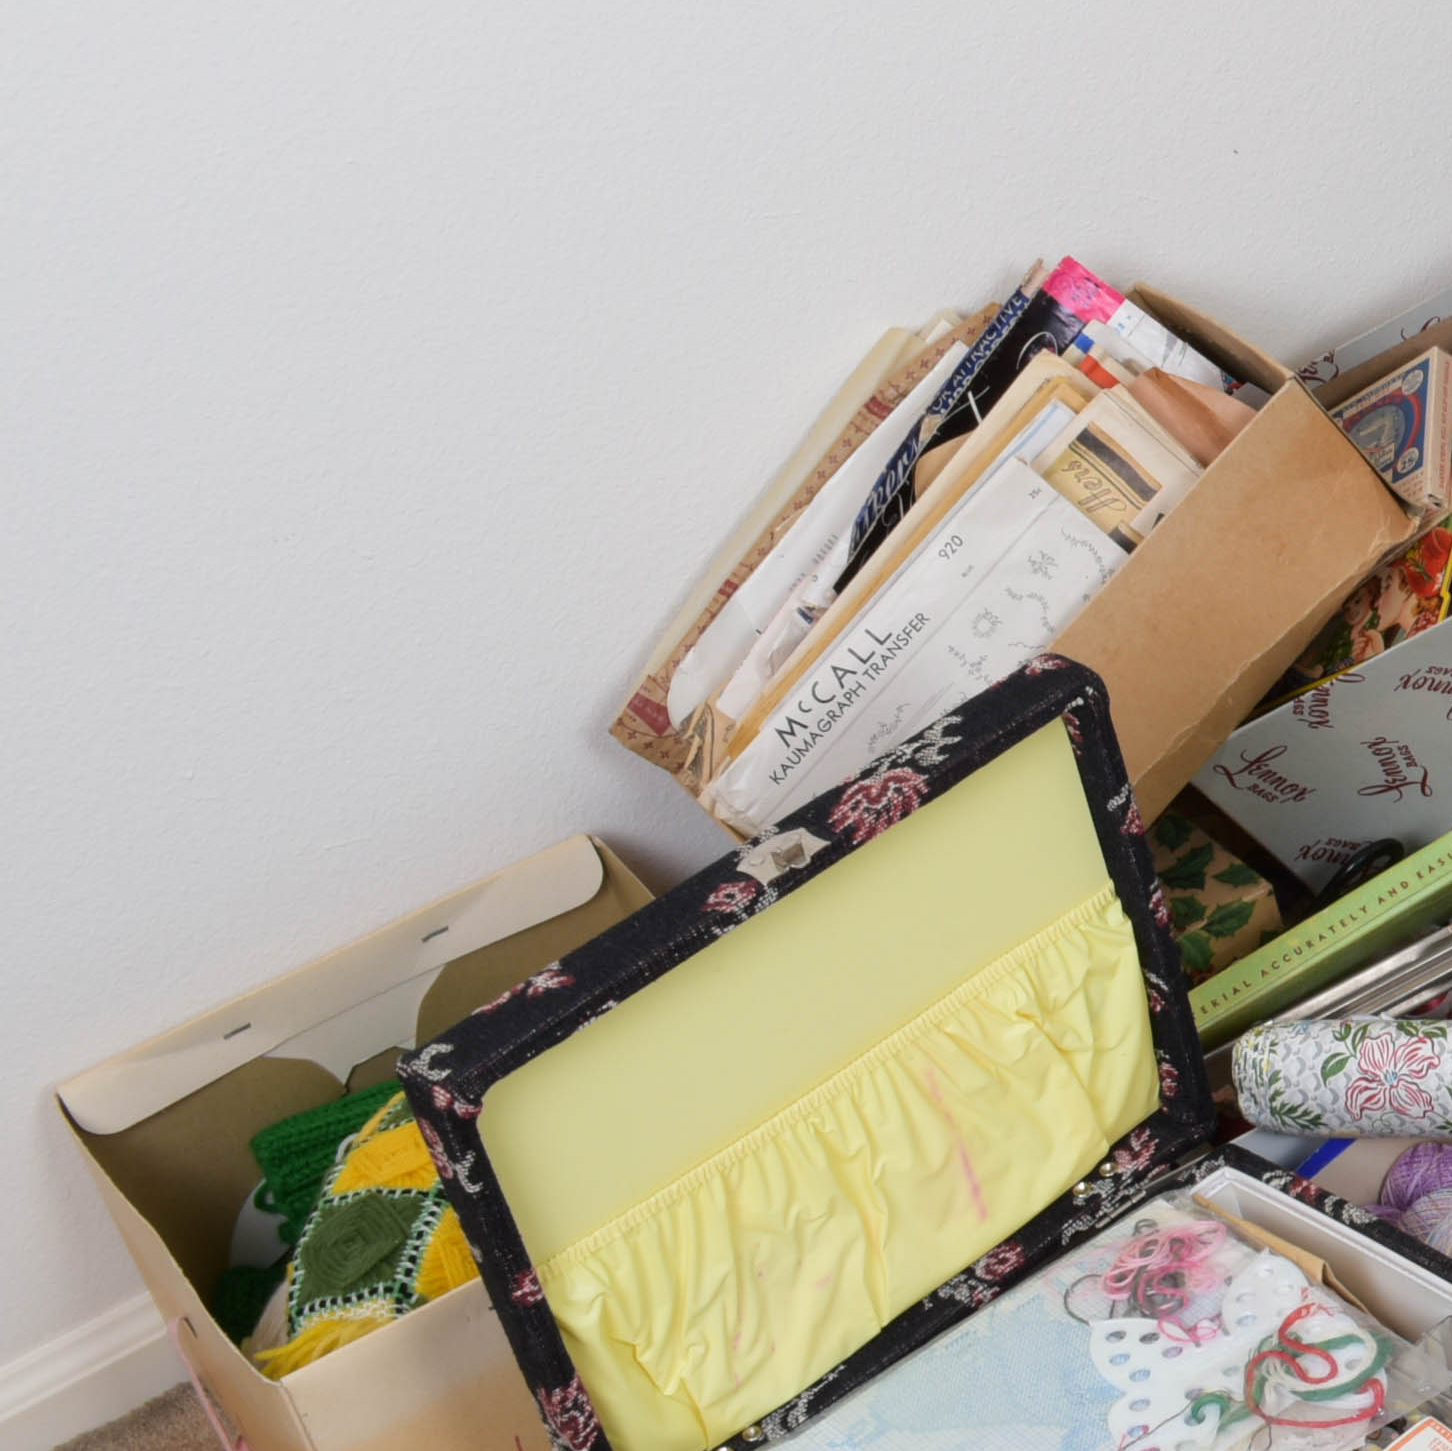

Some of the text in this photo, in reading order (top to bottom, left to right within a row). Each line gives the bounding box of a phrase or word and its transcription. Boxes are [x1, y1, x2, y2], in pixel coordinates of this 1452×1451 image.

[937, 533, 965, 562] 920
[769, 679, 869, 787] KAUMAGRAPH
[861, 611, 931, 684] TRANSFER
[1212, 744, 1317, 804] Lennox
[1246, 783, 1280, 804] BAGS
[1357, 735, 1433, 804] Lennox
[1200, 979, 1252, 1016] ERIAL
[1260, 904, 1369, 979] ACCURATELY
[1377, 879, 1410, 904] AND
